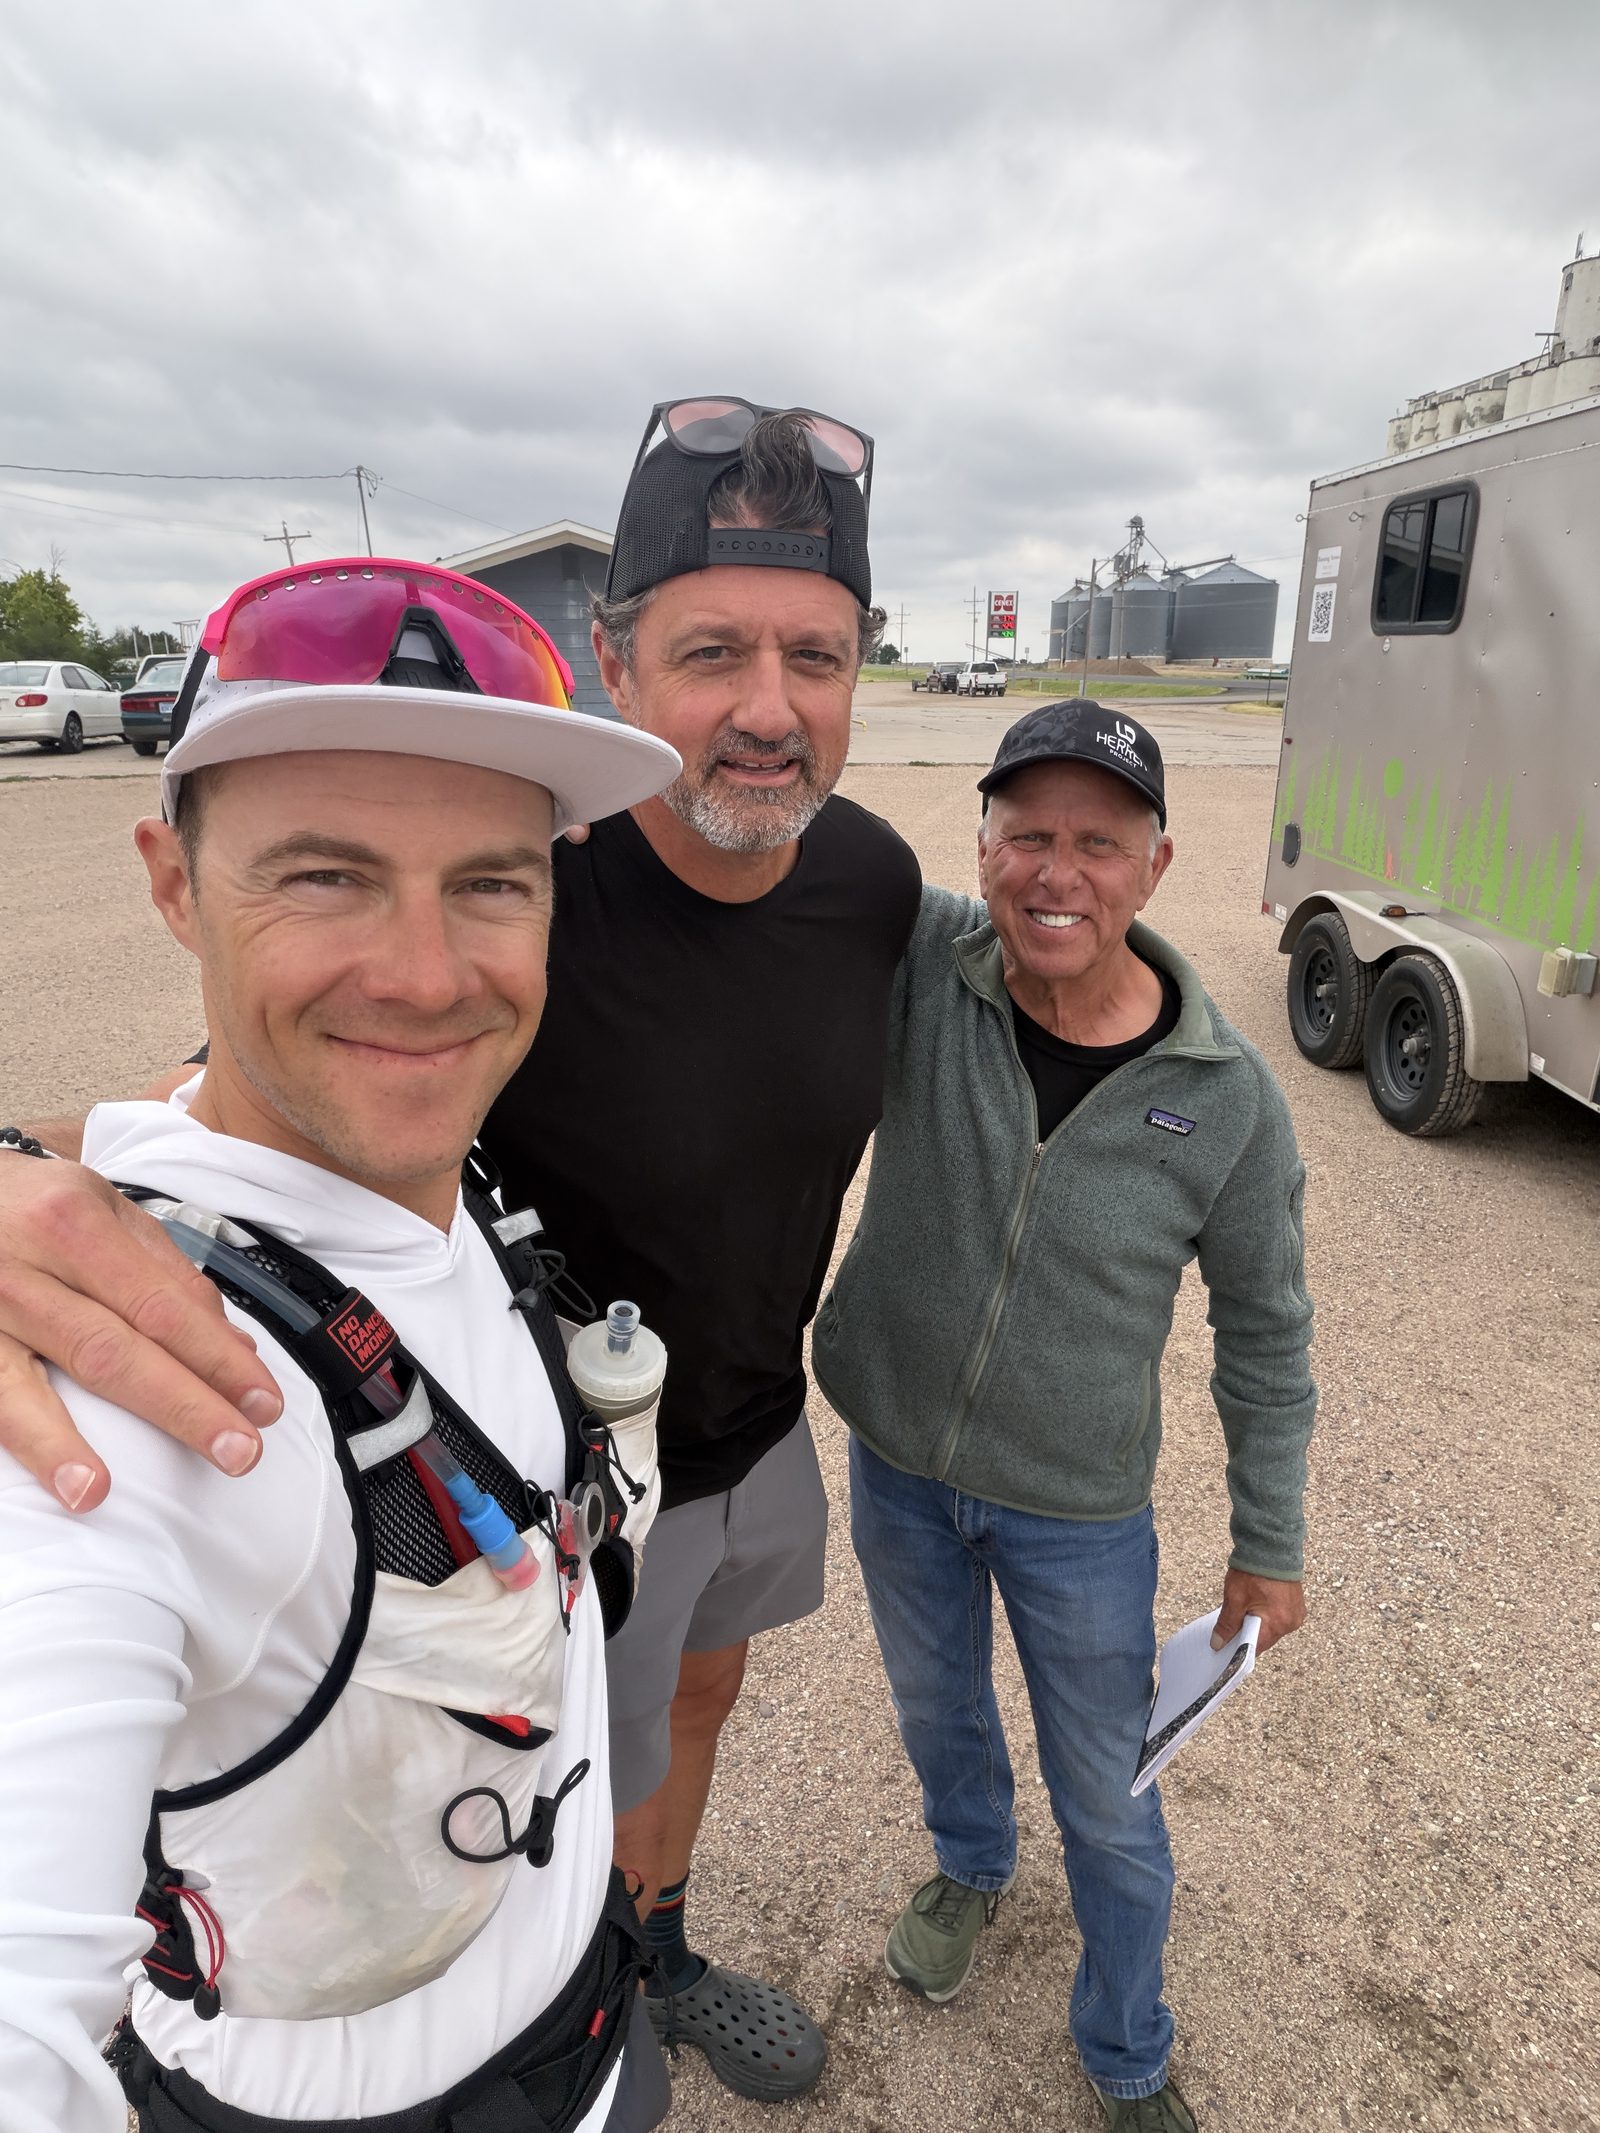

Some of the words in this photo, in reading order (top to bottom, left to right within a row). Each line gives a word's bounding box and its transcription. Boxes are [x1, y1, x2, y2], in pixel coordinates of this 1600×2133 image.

[1109, 748, 1137, 768] PROJECT
[1151, 1117, 1188, 1134] patagonia
[338, 1315, 360, 1341] NO
